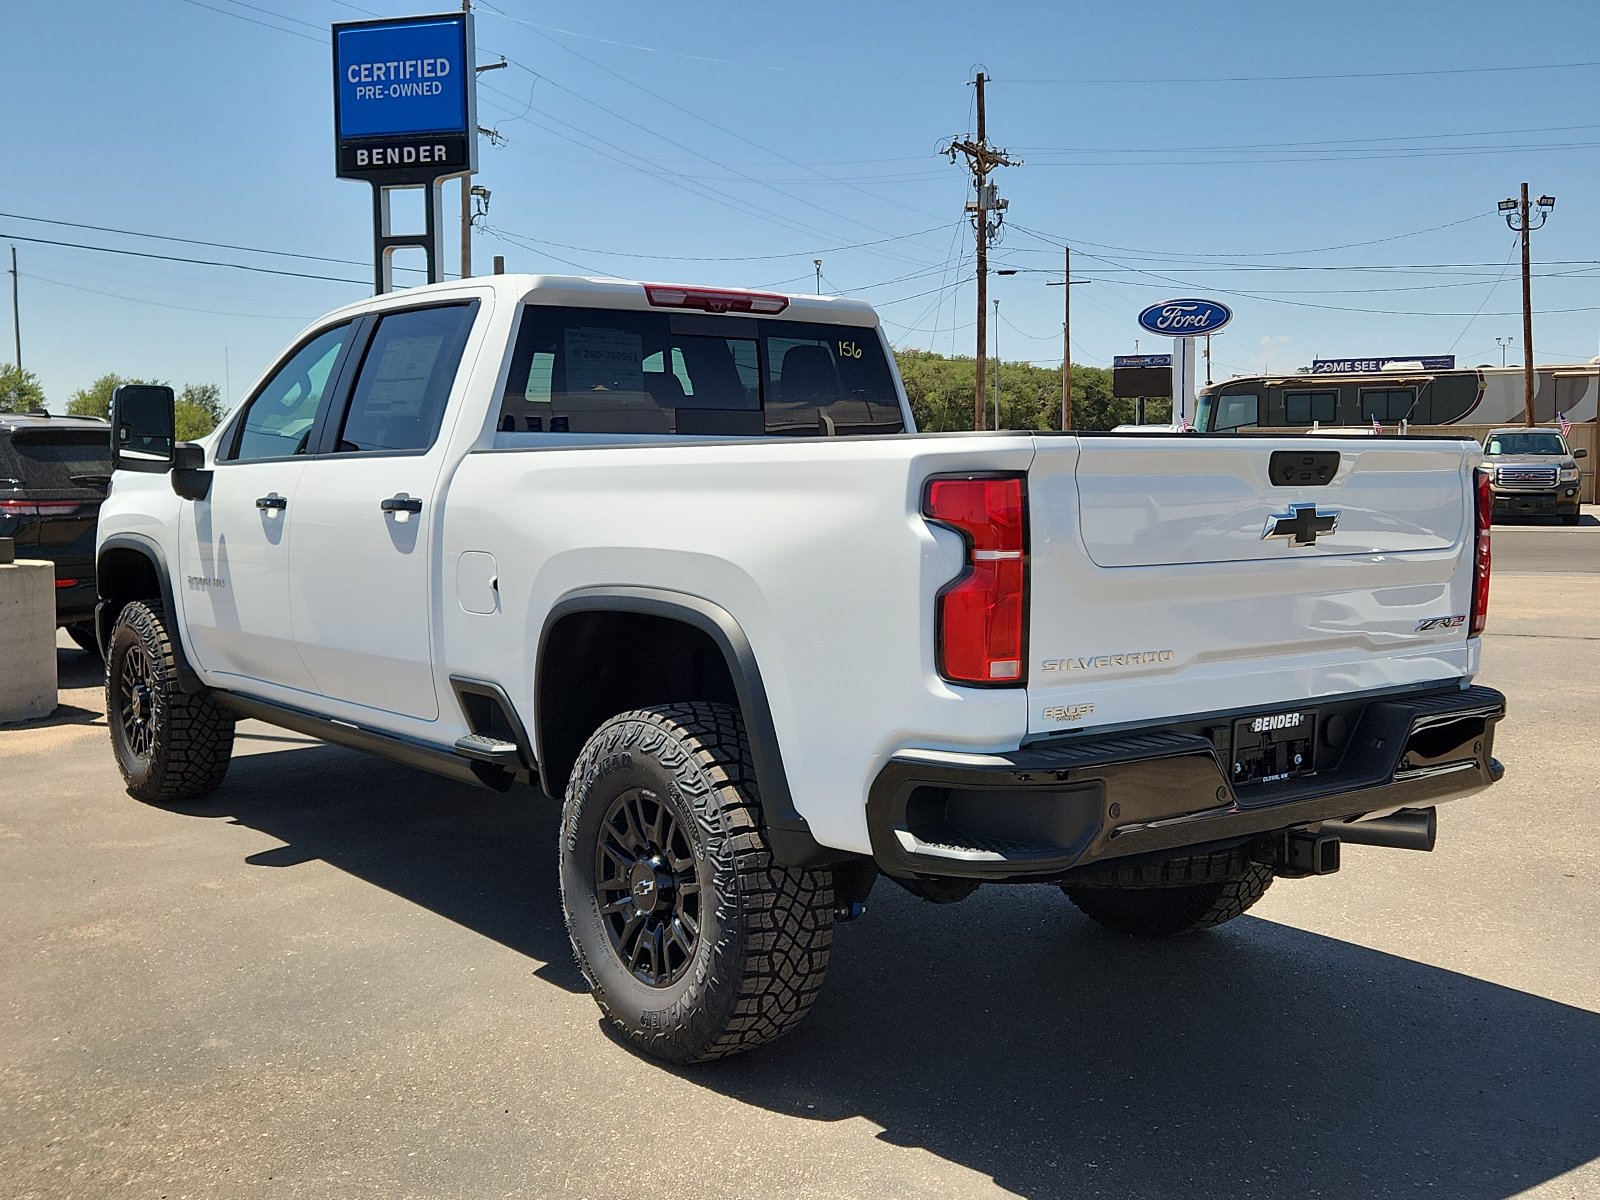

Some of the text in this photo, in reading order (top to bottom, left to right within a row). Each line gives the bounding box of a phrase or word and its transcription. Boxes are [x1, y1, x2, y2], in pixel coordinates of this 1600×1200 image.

[347, 58, 450, 83] CERTIFIED
[356, 81, 442, 100] PRE-OWNED
[356, 145, 447, 166] BENDER
[1156, 305, 1212, 329] Ford
[838, 340, 862, 359] 156
[1316, 361, 1352, 372] COME
[1353, 361, 1377, 371] SEE
[1414, 615, 1466, 631] ZR2
[1042, 650, 1175, 672] SILVERADO
[1253, 713, 1300, 732] BENDER
